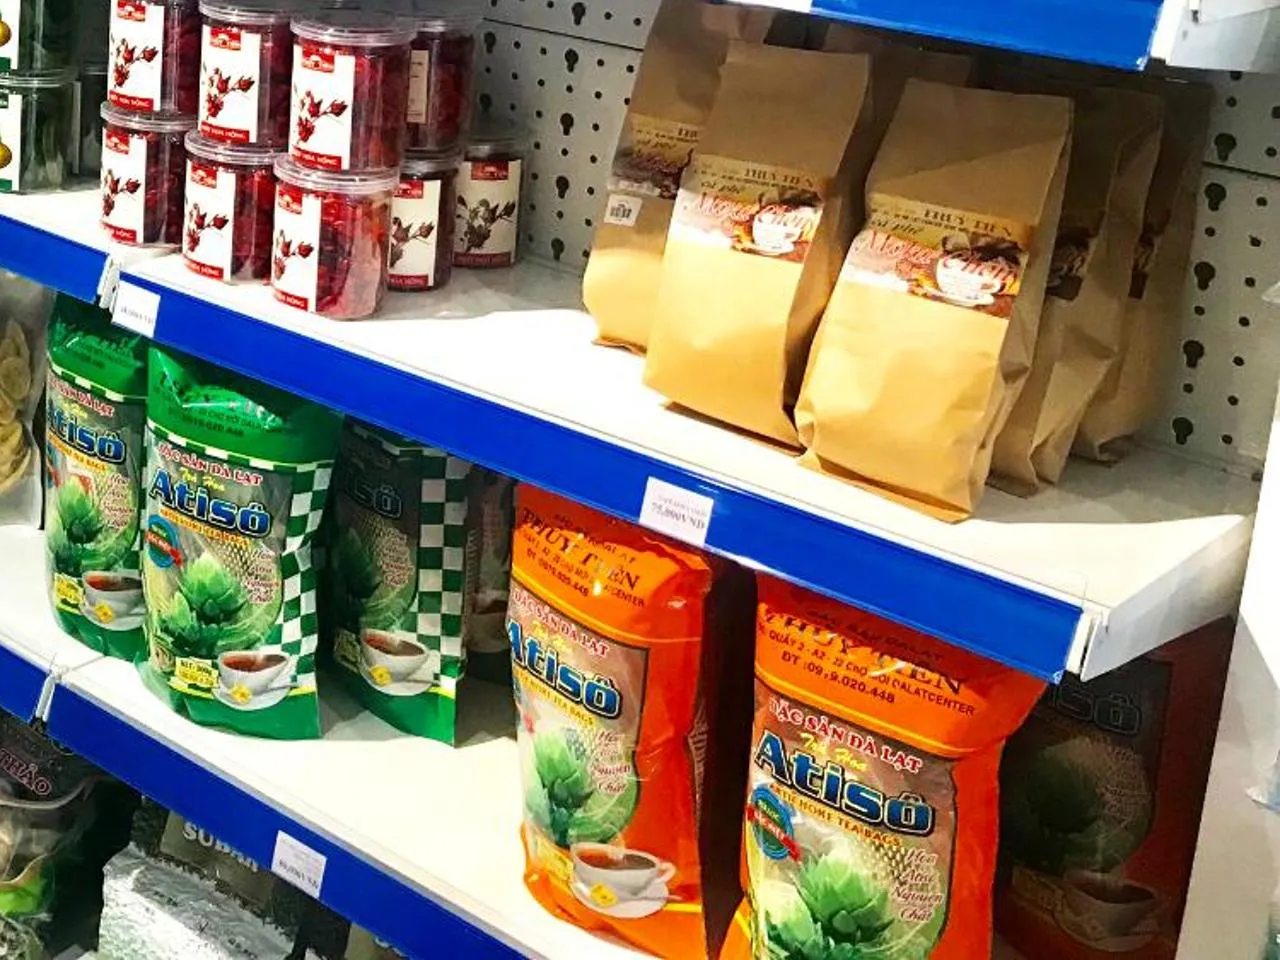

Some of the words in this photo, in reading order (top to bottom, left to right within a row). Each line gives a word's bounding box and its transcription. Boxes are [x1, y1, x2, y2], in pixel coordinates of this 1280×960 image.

[149, 466, 273, 539] Atisô
[805, 713, 847, 744] SẢN
[880, 743, 924, 776] LẠT
[755, 727, 936, 837] Atisô
[861, 826, 904, 848] BAGS
